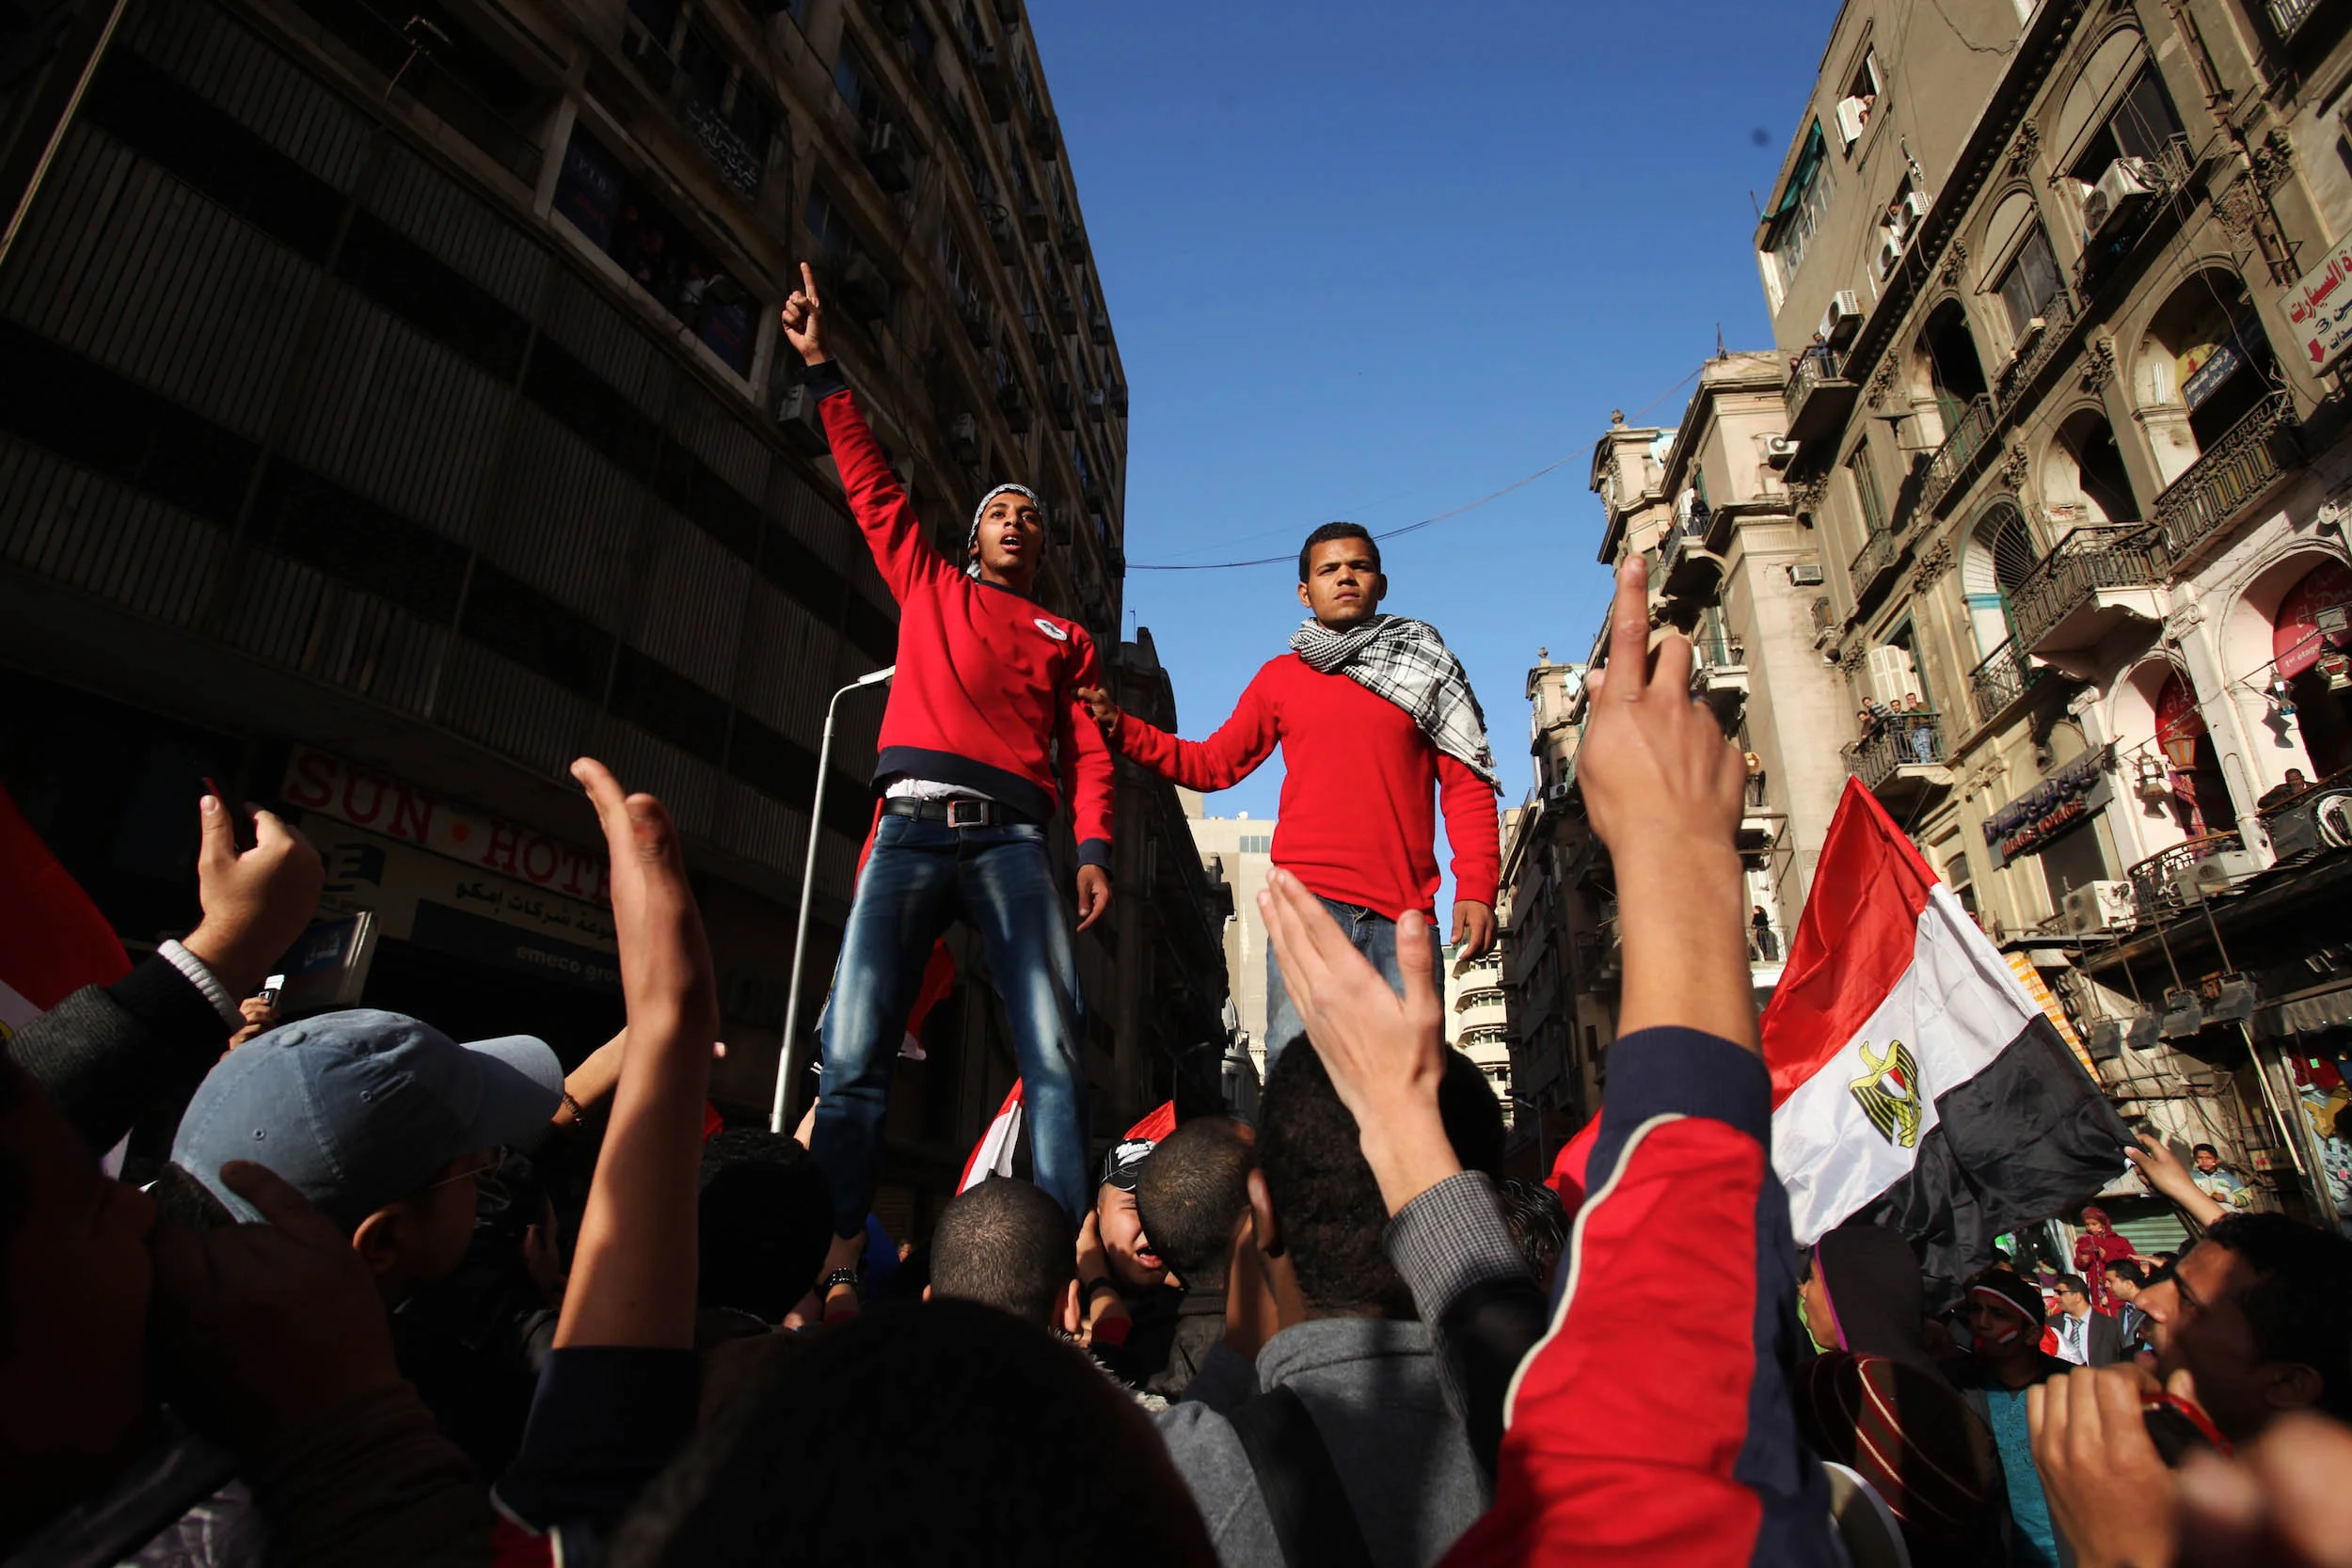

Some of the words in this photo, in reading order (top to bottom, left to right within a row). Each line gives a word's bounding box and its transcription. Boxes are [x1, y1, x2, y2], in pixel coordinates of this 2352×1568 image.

[288, 753, 440, 845] SUN
[481, 819, 612, 908] HOTE
[508, 895, 571, 926] شركات
[576, 911, 616, 941] موعة
[516, 944, 581, 974] emeco
[584, 963, 620, 982] gro
